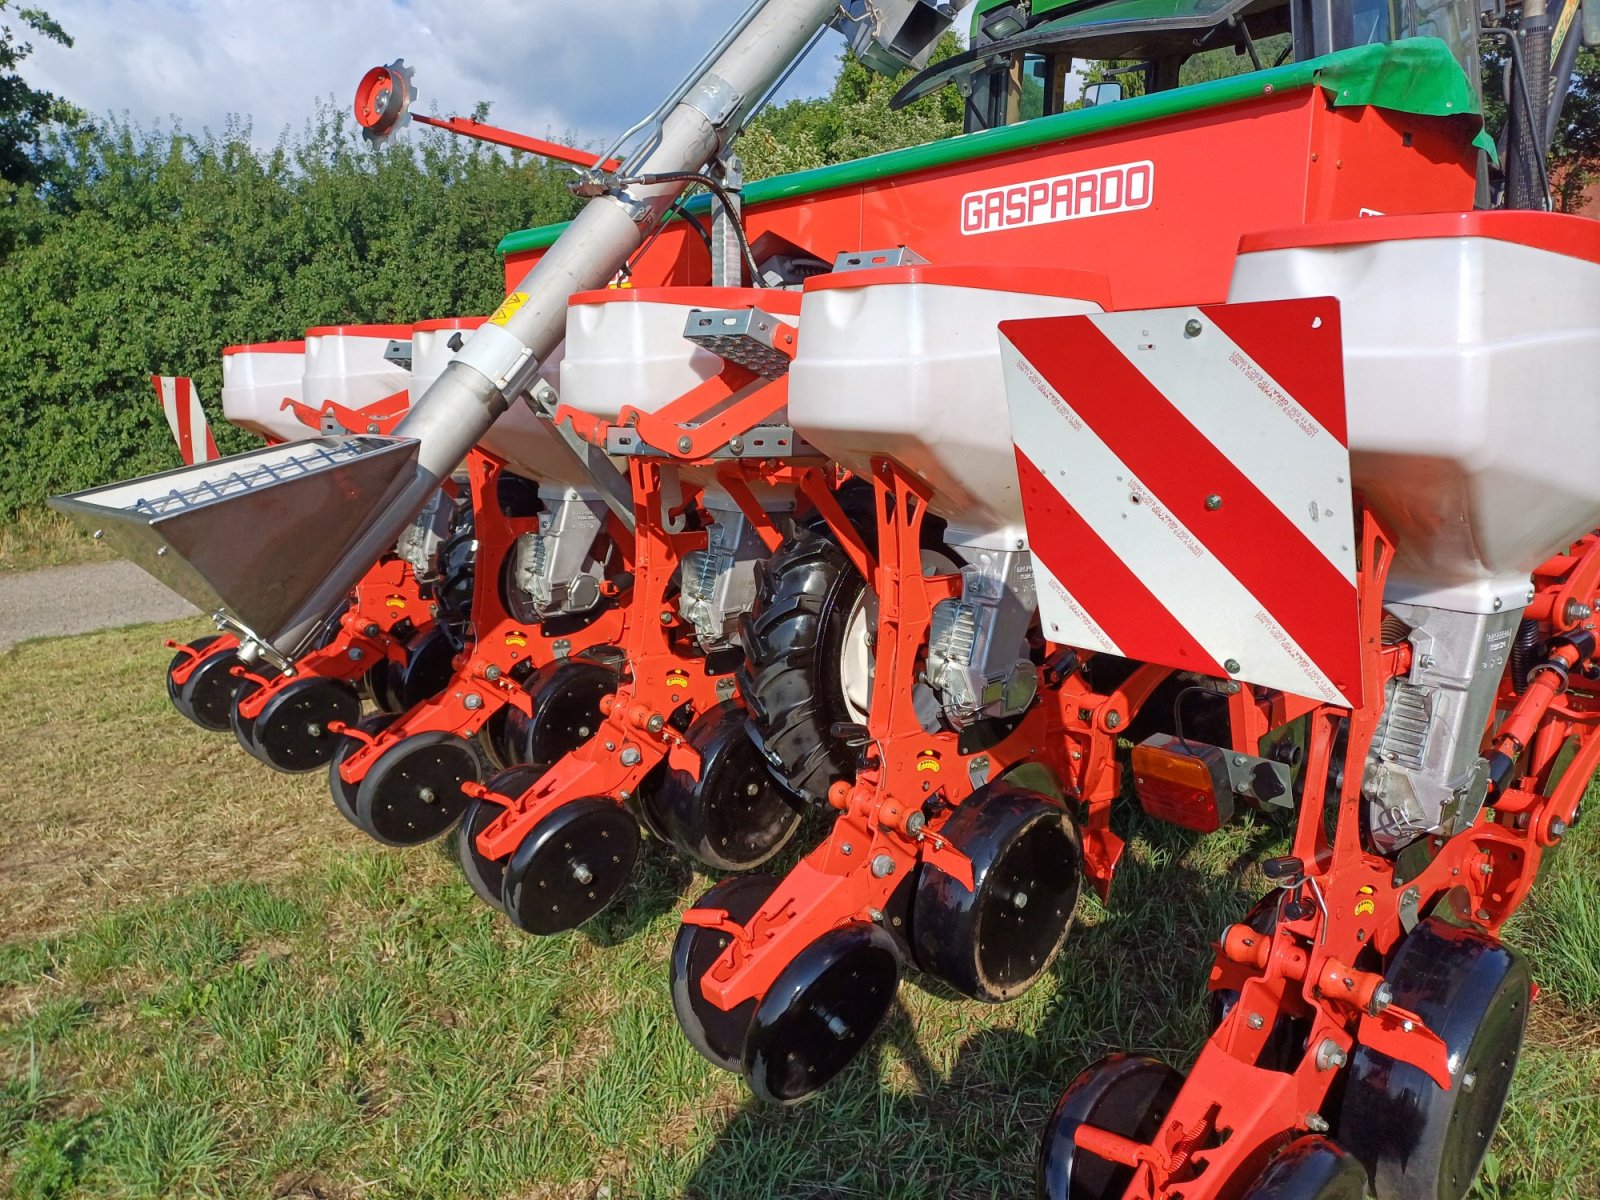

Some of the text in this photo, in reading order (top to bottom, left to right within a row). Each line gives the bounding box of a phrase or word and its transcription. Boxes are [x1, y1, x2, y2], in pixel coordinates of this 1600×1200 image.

[964, 164, 1150, 232] GASPARDO
[1250, 368, 1263, 381] ESC
[1261, 378, 1271, 388] TP
[1228, 355, 1239, 366] DIN
[1244, 370, 1255, 381] 030
[1256, 382, 1273, 398] GEKA
[1274, 399, 1284, 408] TP
[1282, 406, 1295, 419] ESC
[1271, 388, 1289, 406] GEKA
